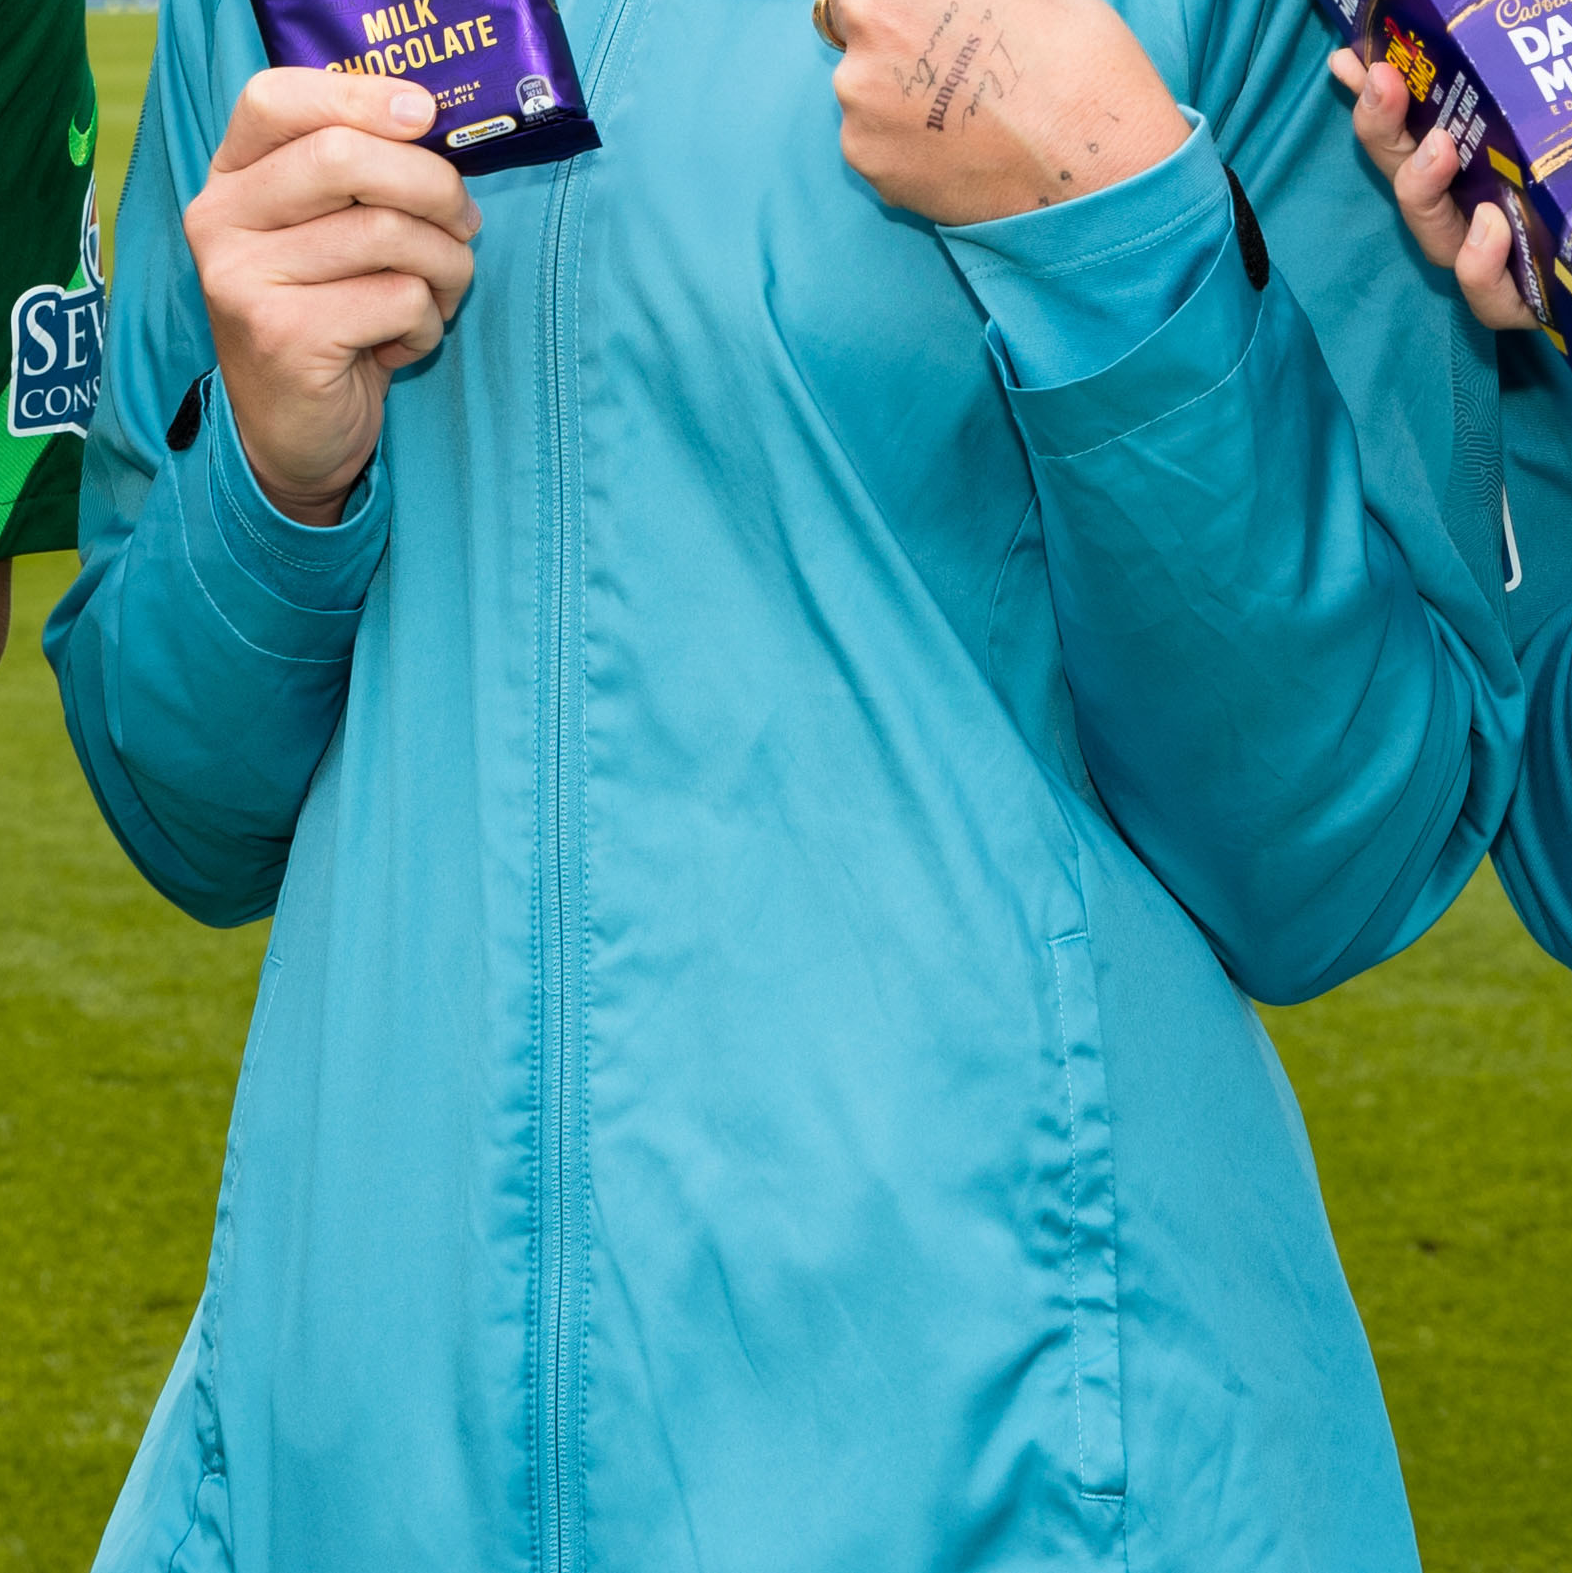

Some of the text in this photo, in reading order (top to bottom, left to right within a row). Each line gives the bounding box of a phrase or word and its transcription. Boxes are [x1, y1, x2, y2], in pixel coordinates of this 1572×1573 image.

[892, 0, 960, 100] country
[453, 80, 481, 95] MILK
[926, 32, 982, 133] sunburnt
[1517, 223, 1532, 265] MILK
[1525, 263, 1547, 323] DAIRY
